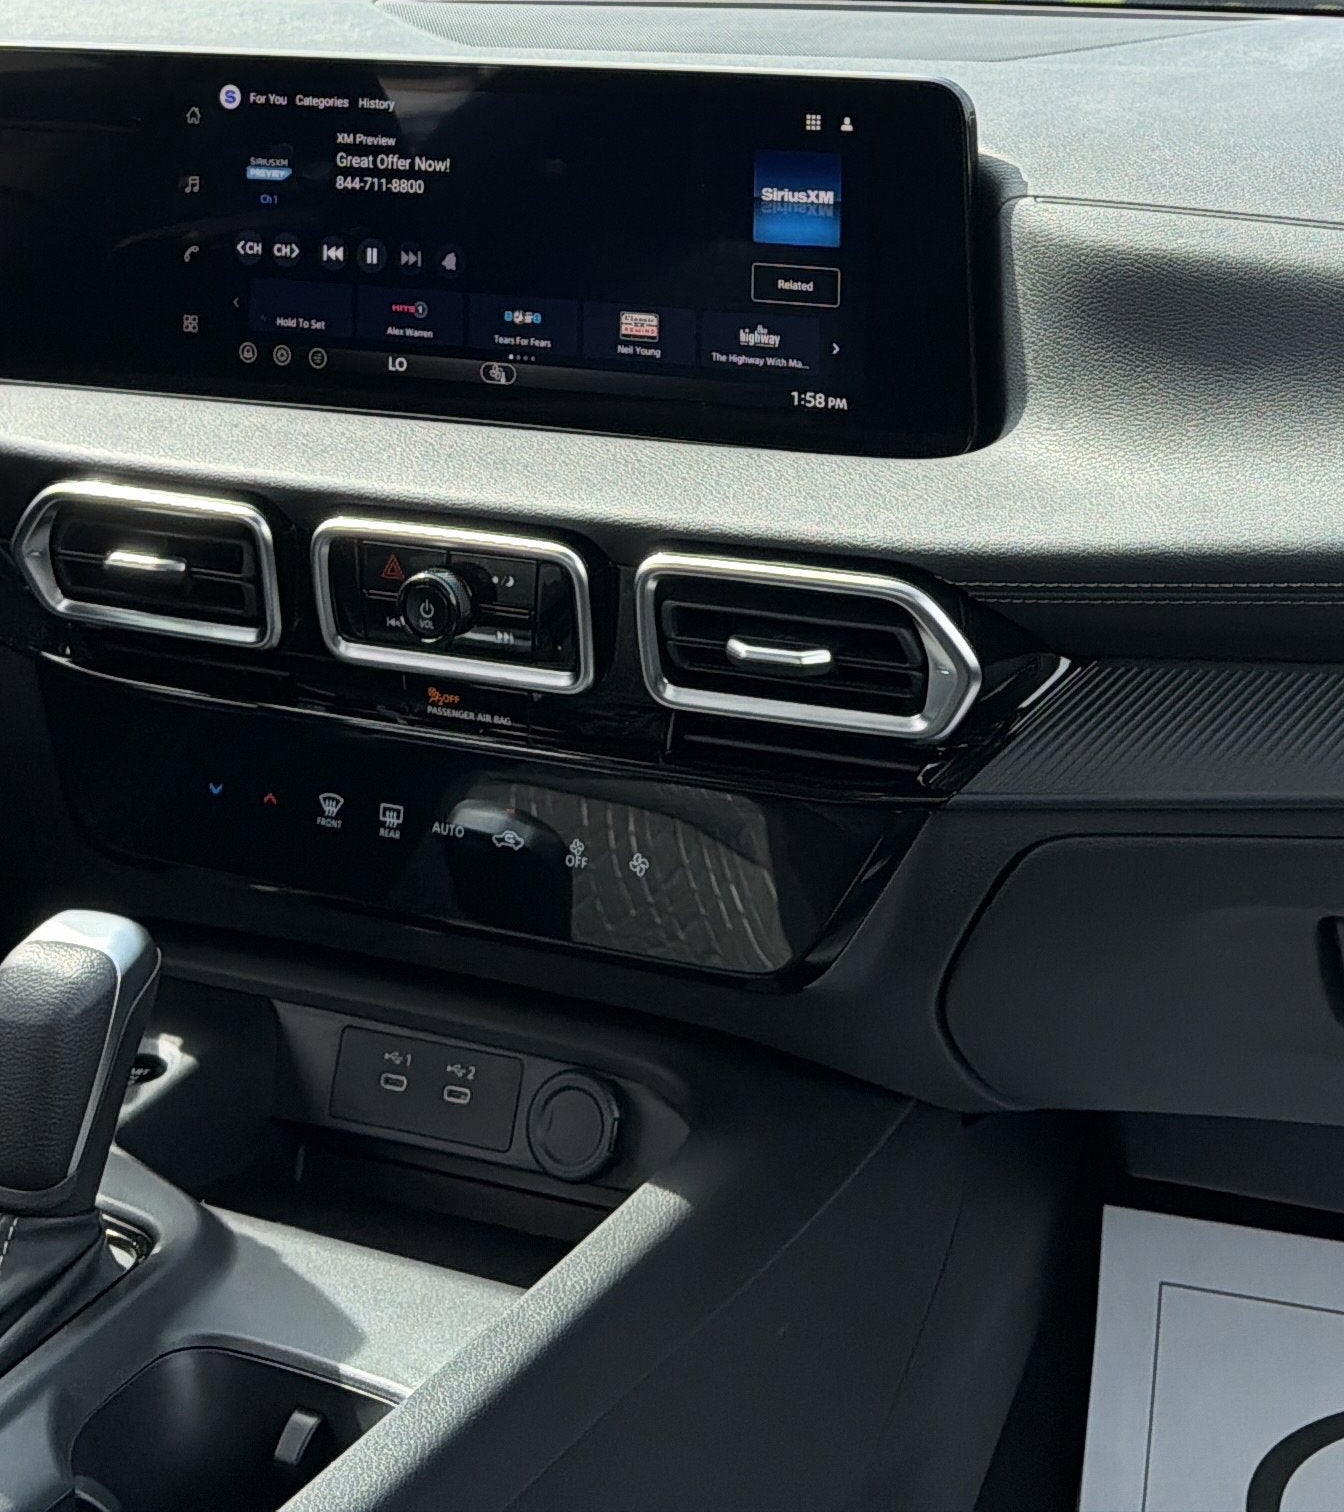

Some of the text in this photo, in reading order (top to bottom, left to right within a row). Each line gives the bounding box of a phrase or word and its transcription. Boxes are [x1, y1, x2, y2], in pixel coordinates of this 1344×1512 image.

[250, 93, 287, 106] For You
[295, 94, 349, 110] Categories
[358, 97, 395, 112] History
[336, 133, 396, 147] XM Preview
[336, 152, 450, 172] Great Offer Now!
[335, 176, 425, 194] 844-711-8800
[260, 194, 272, 204] Ch
[761, 187, 834, 204] SiriusXM
[777, 279, 814, 292] Related
[276, 316, 325, 330] Hold To Set
[386, 326, 433, 339] Alex Warren
[494, 334, 551, 348] Tears For Fears
[617, 344, 661, 359] Neil Young
[388, 355, 407, 372] LO
[712, 351, 727, 362] The
[728, 354, 765, 367] Highway
[766, 357, 787, 368] With
[791, 391, 848, 410] 1:58 PM
[419, 619, 434, 630] VOL
[443, 694, 460, 704] OFF
[427, 705, 512, 726] PASSENGER AIR BAG
[316, 816, 342, 829] FRONT
[431, 821, 465, 838] AUTO
[379, 827, 401, 840] REAR
[565, 855, 589, 869] OFF
[406, 1053, 412, 1067] 1
[467, 1066, 476, 1080] 2
